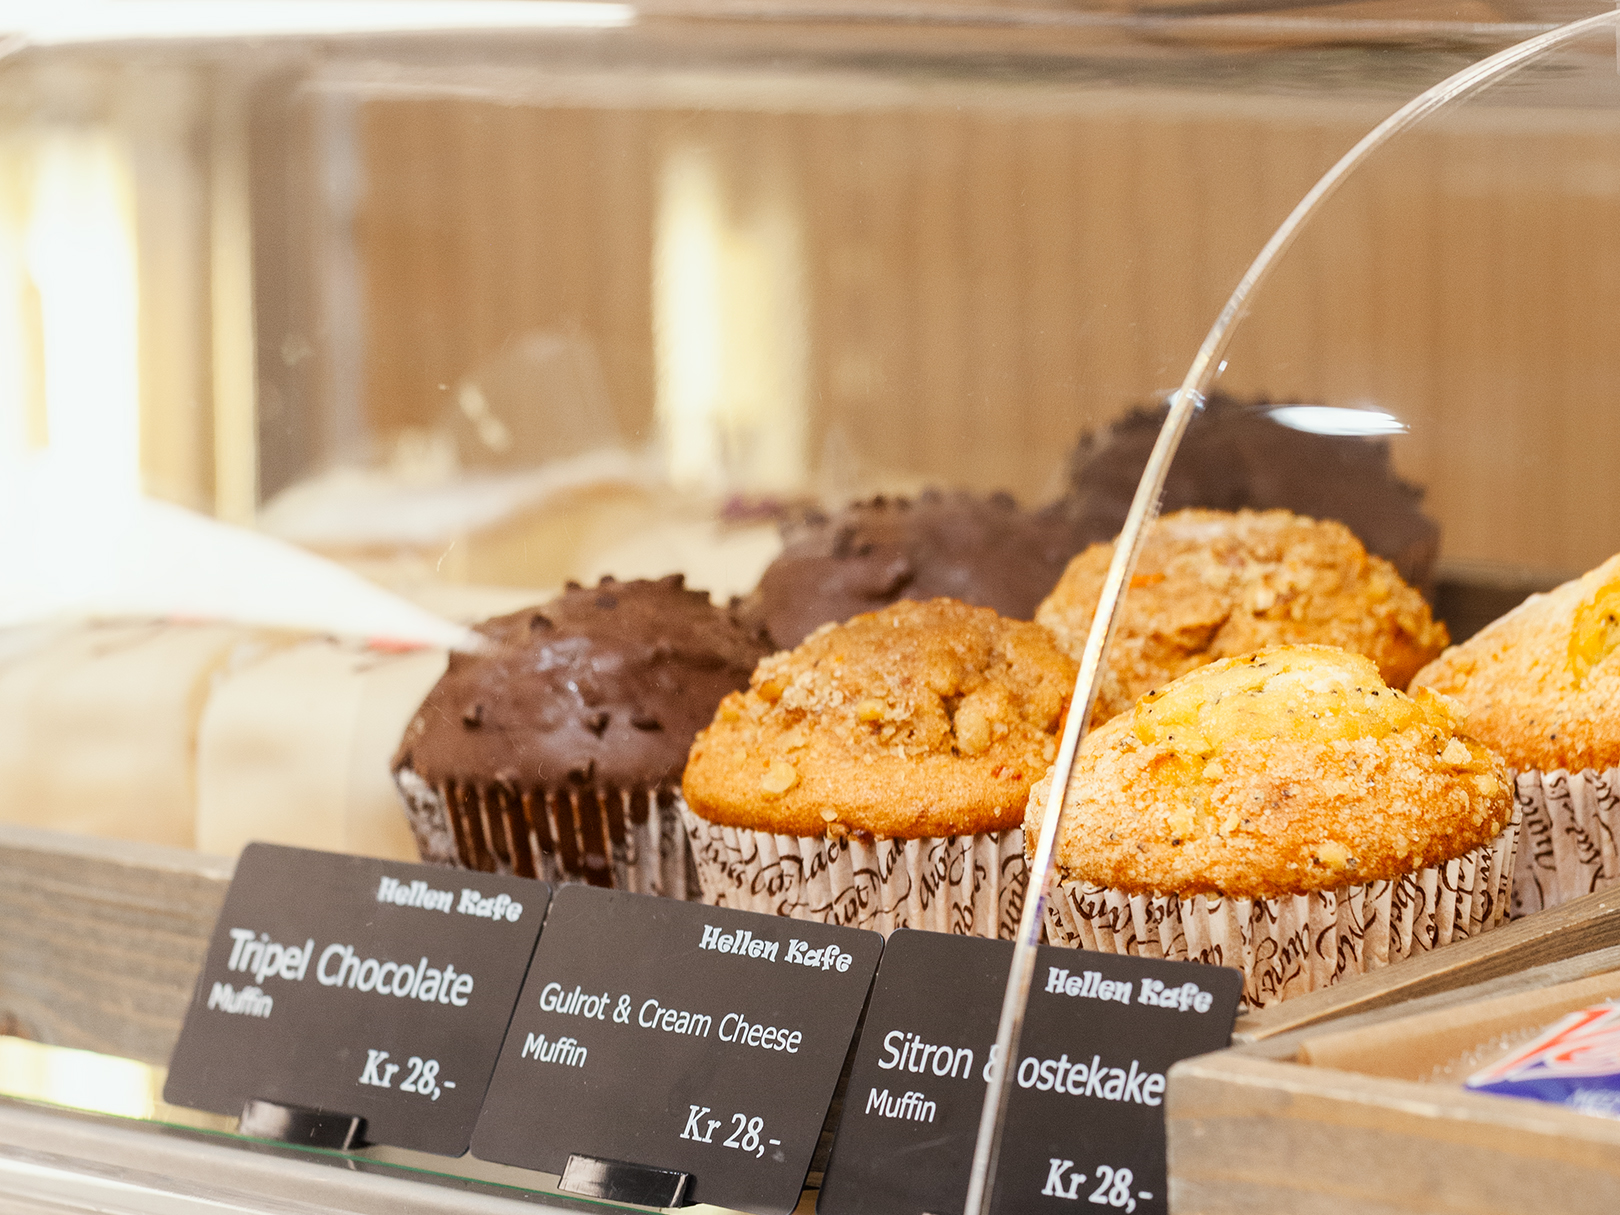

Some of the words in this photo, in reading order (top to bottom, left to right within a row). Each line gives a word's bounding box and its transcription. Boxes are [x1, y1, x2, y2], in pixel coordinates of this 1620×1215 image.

[376, 876, 453, 913] Hellen
[457, 888, 523, 923] Kafe
[227, 927, 315, 984] Tripel
[316, 943, 474, 1007] Chocolate
[699, 924, 780, 963] Hellen
[784, 938, 853, 972] Kafe
[207, 982, 274, 1018] Muffin
[1045, 967, 1132, 1005] Hellen
[1137, 978, 1213, 1014] Kafe
[539, 982, 610, 1020] Gulrot
[612, 994, 631, 1024] &
[638, 999, 711, 1037] Cream
[718, 1012, 803, 1053] Cheese
[359, 1049, 399, 1089] Kr
[400, 1056, 456, 1101] 28,-
[522, 1032, 587, 1068] Muffin
[878, 1030, 974, 1080] Sitron
[1017, 1054, 1166, 1106] ostekake
[865, 1088, 937, 1122] Muffin
[680, 1104, 721, 1144] Kr
[723, 1113, 781, 1159] 28,-
[1041, 1158, 1087, 1200] Kr
[1088, 1165, 1153, 1214] 28,-
